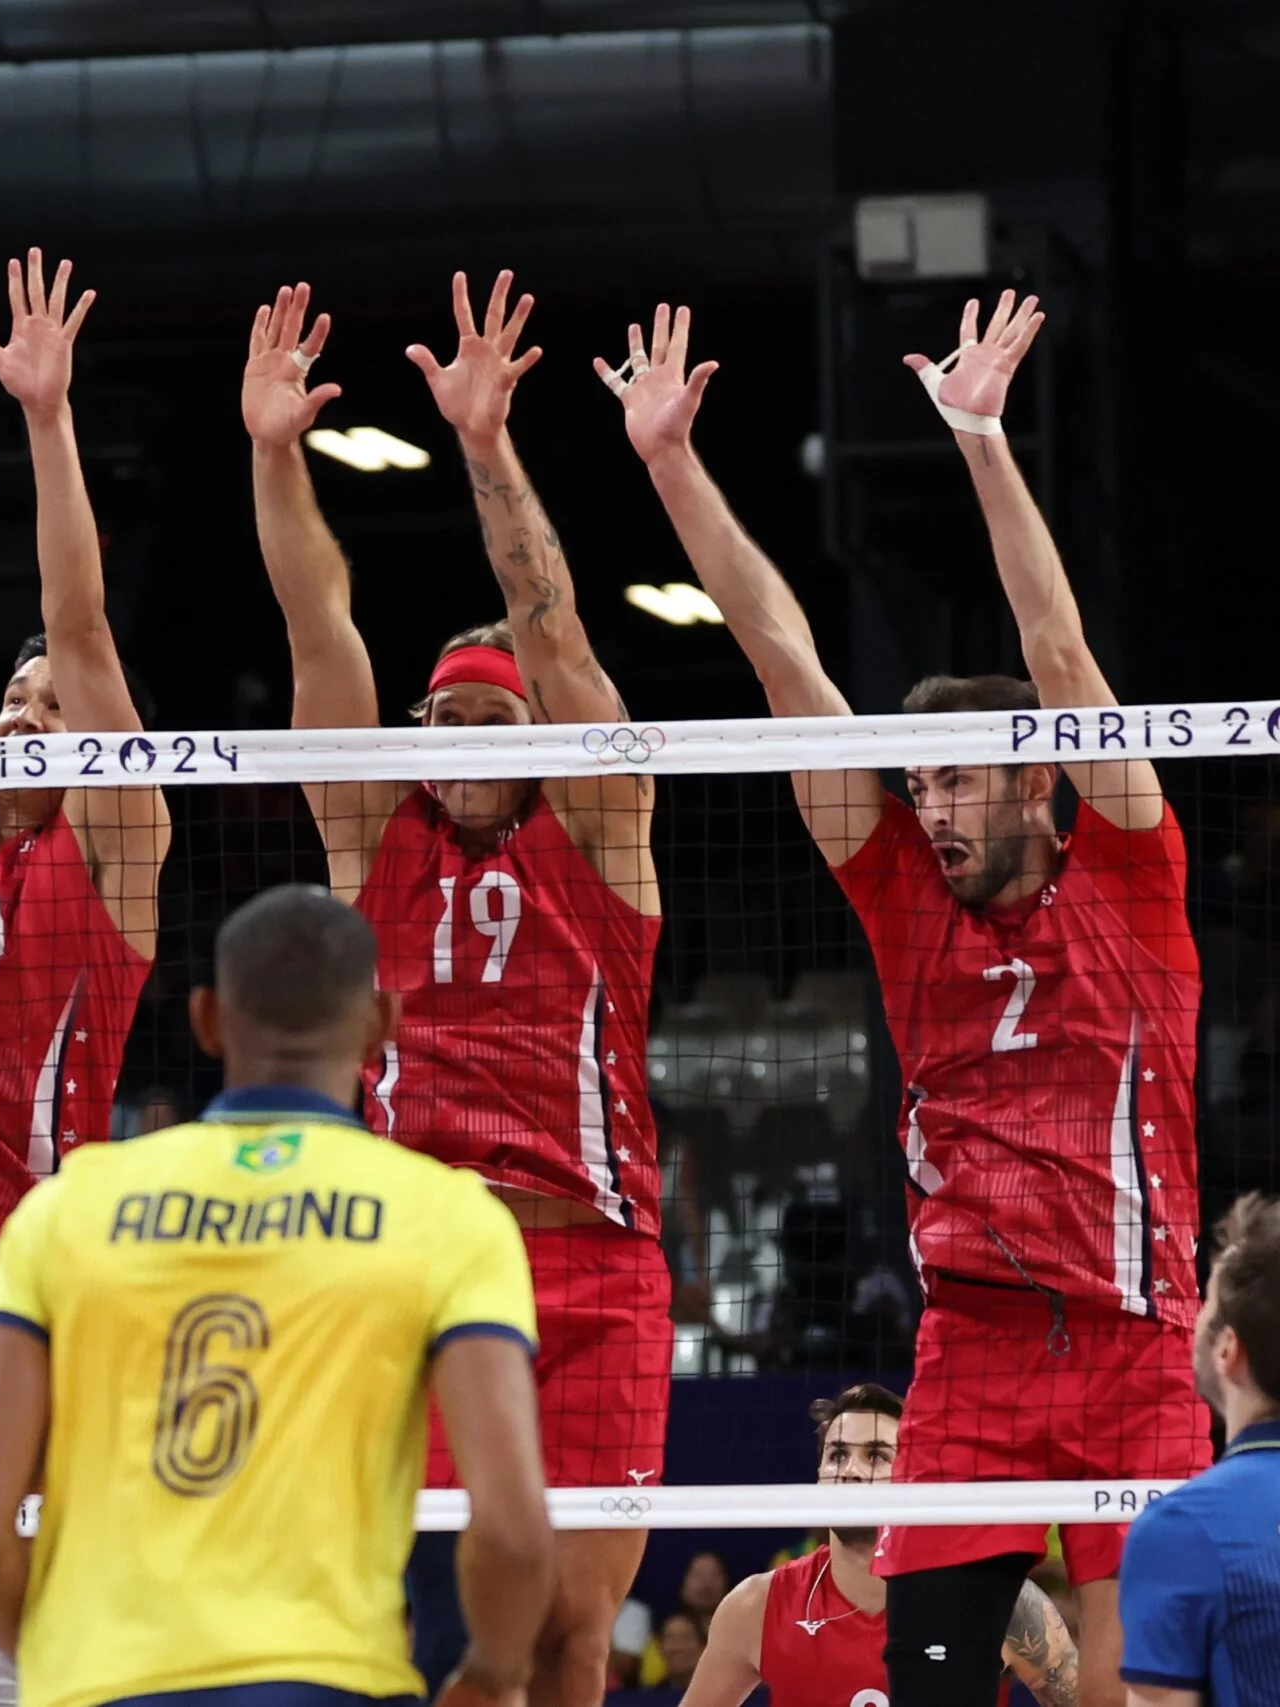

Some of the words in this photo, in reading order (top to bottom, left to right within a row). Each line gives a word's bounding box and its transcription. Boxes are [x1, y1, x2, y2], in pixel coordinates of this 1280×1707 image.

[434, 870, 521, 984] 19
[982, 957, 1038, 1053] 2
[108, 1189, 382, 1245] ADRIANO
[152, 1292, 271, 1499] 6
